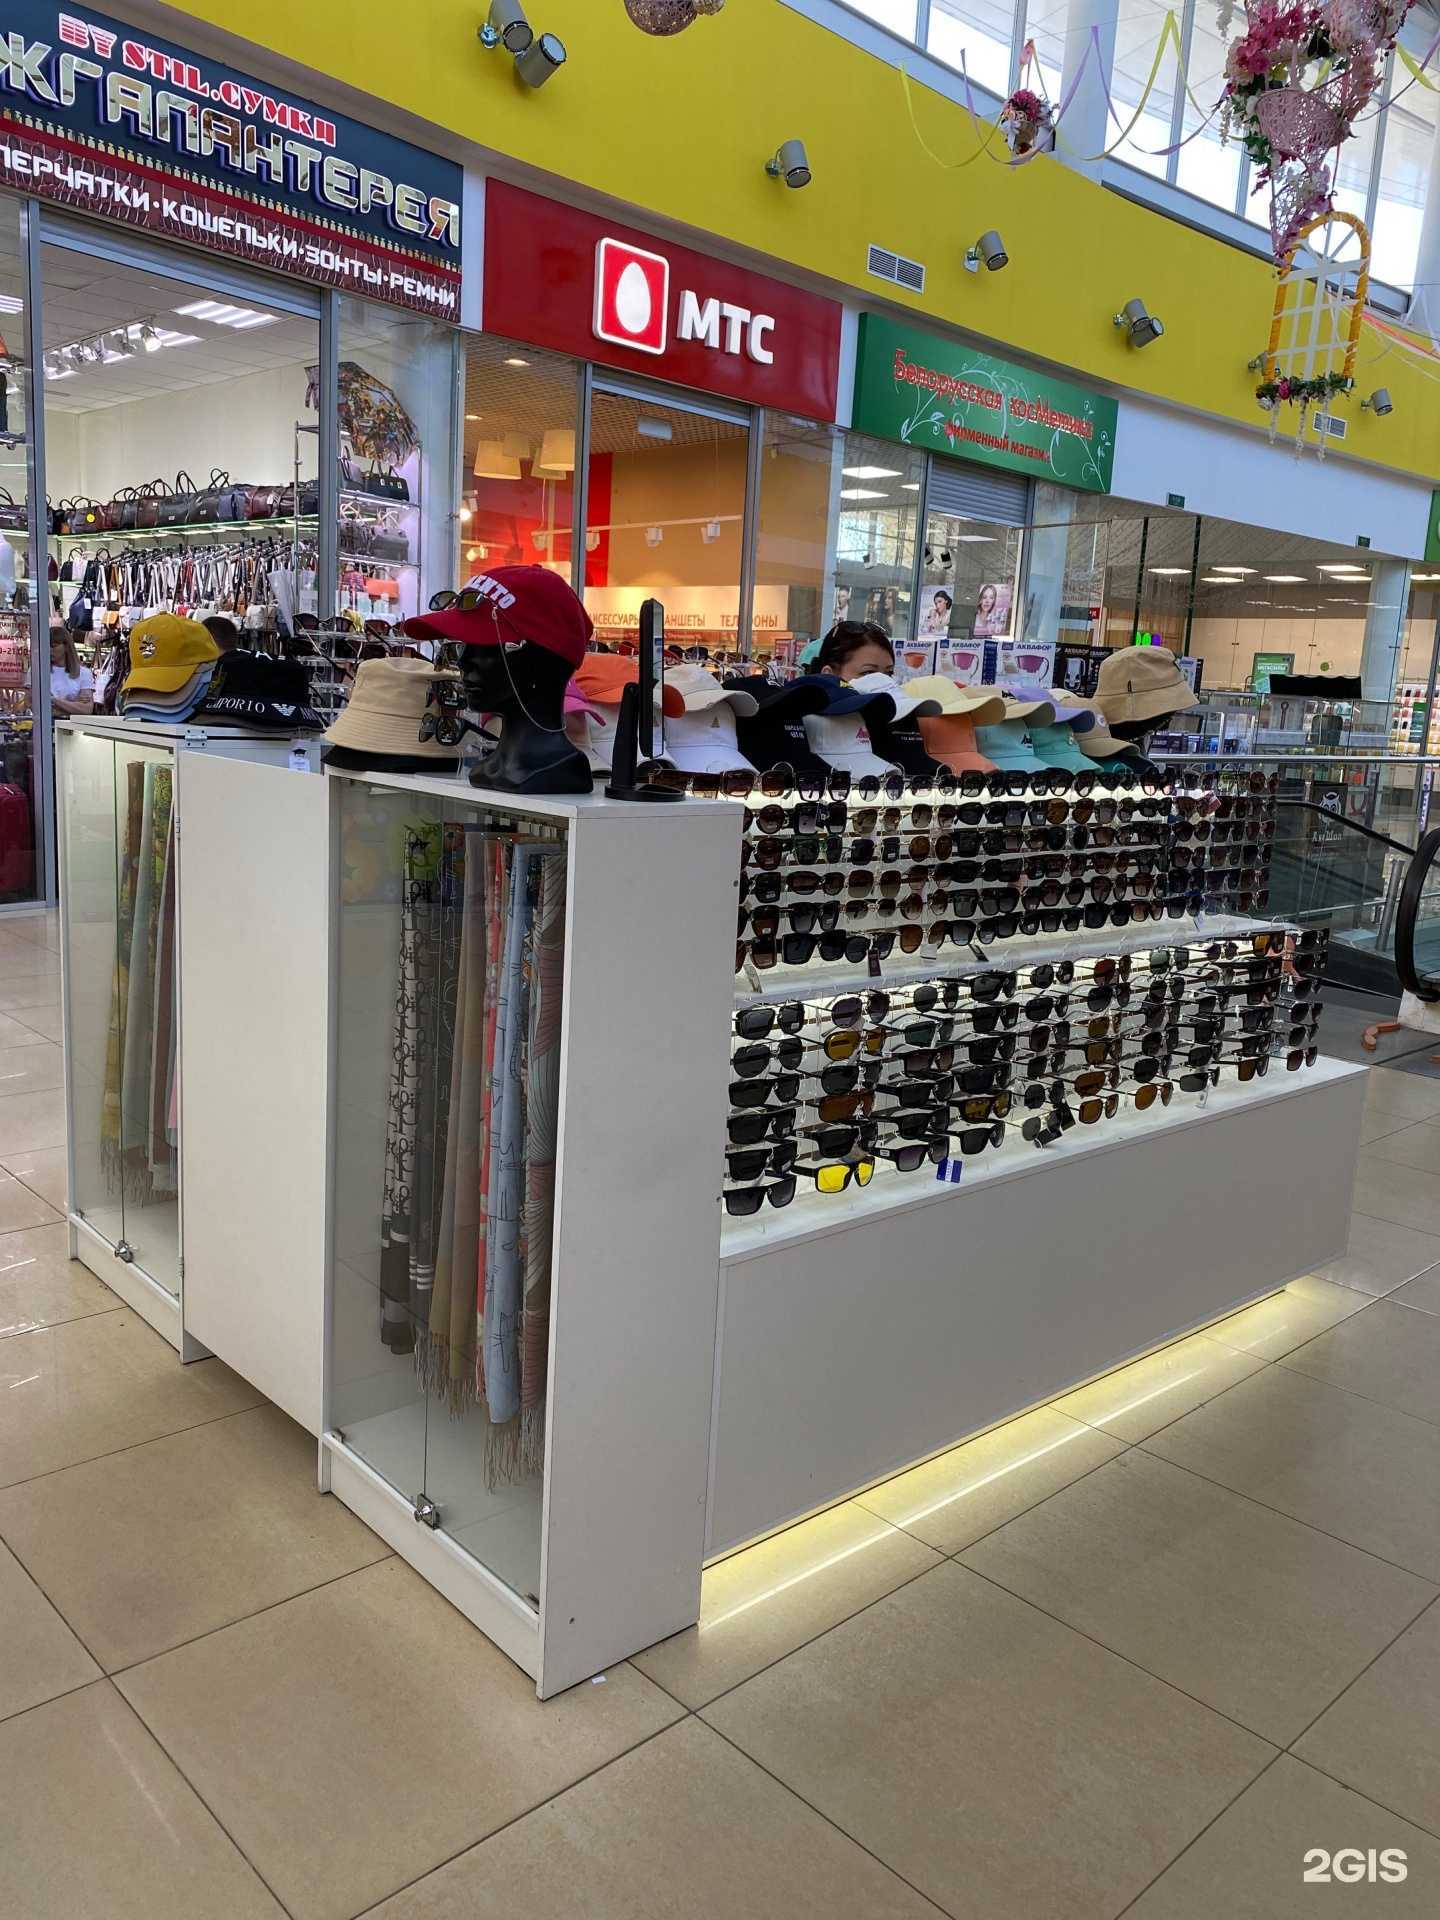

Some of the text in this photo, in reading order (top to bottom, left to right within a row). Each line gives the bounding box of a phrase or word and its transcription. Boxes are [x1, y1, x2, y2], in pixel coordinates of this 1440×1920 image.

[58, 12, 118, 59] BY
[162, 197, 298, 258] КОШЕЛЬКИ
[305, 244, 382, 286] ЗОНТЫ
[390, 271, 455, 308] РЕМНИ
[676, 289, 776, 365] МТС
[894, 348, 1004, 411] Белорусская
[590, 612, 779, 629] КСЕССУАРЫ АНШЕТЫ ТЕЛОНЫ
[1016, 643, 1052, 651] АКВАФОР
[206, 697, 266, 714] MPORIO
